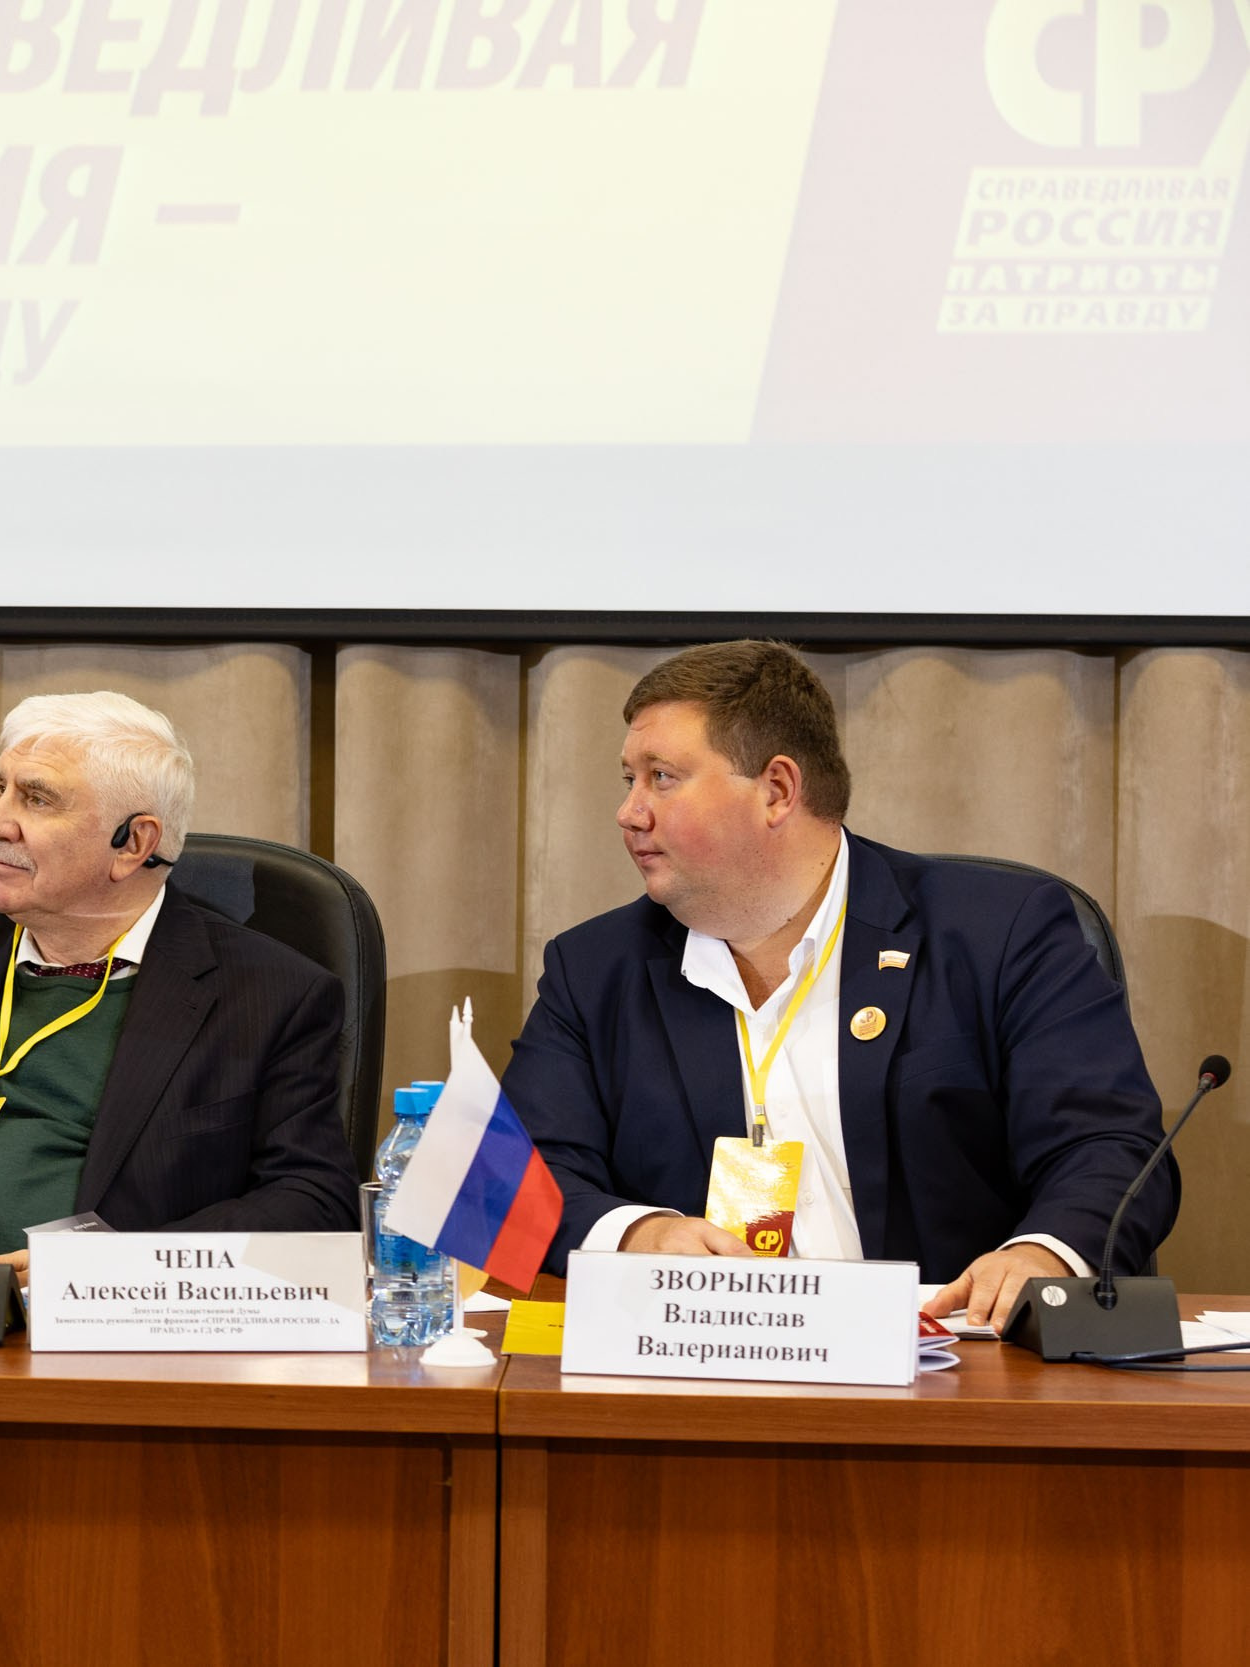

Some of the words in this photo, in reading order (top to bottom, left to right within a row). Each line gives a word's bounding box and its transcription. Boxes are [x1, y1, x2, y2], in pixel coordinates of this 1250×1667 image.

[976, 176, 1231, 204] СПРАВЕДЛИВАЯ
[965, 208, 1223, 247] РОССИЯ
[946, 264, 1220, 291] ПАТРИОТЫ
[947, 301, 999, 327] ЗА
[1022, 301, 1203, 328] ПРАВДУ
[154, 1249, 235, 1269] ЧЕПА
[62, 1281, 167, 1301] Алексей
[177, 1281, 330, 1301] Васильевич
[649, 1269, 822, 1296] ЗВОРЫКИН
[663, 1302, 806, 1328] Владислав
[636, 1335, 829, 1364] Валерианович
